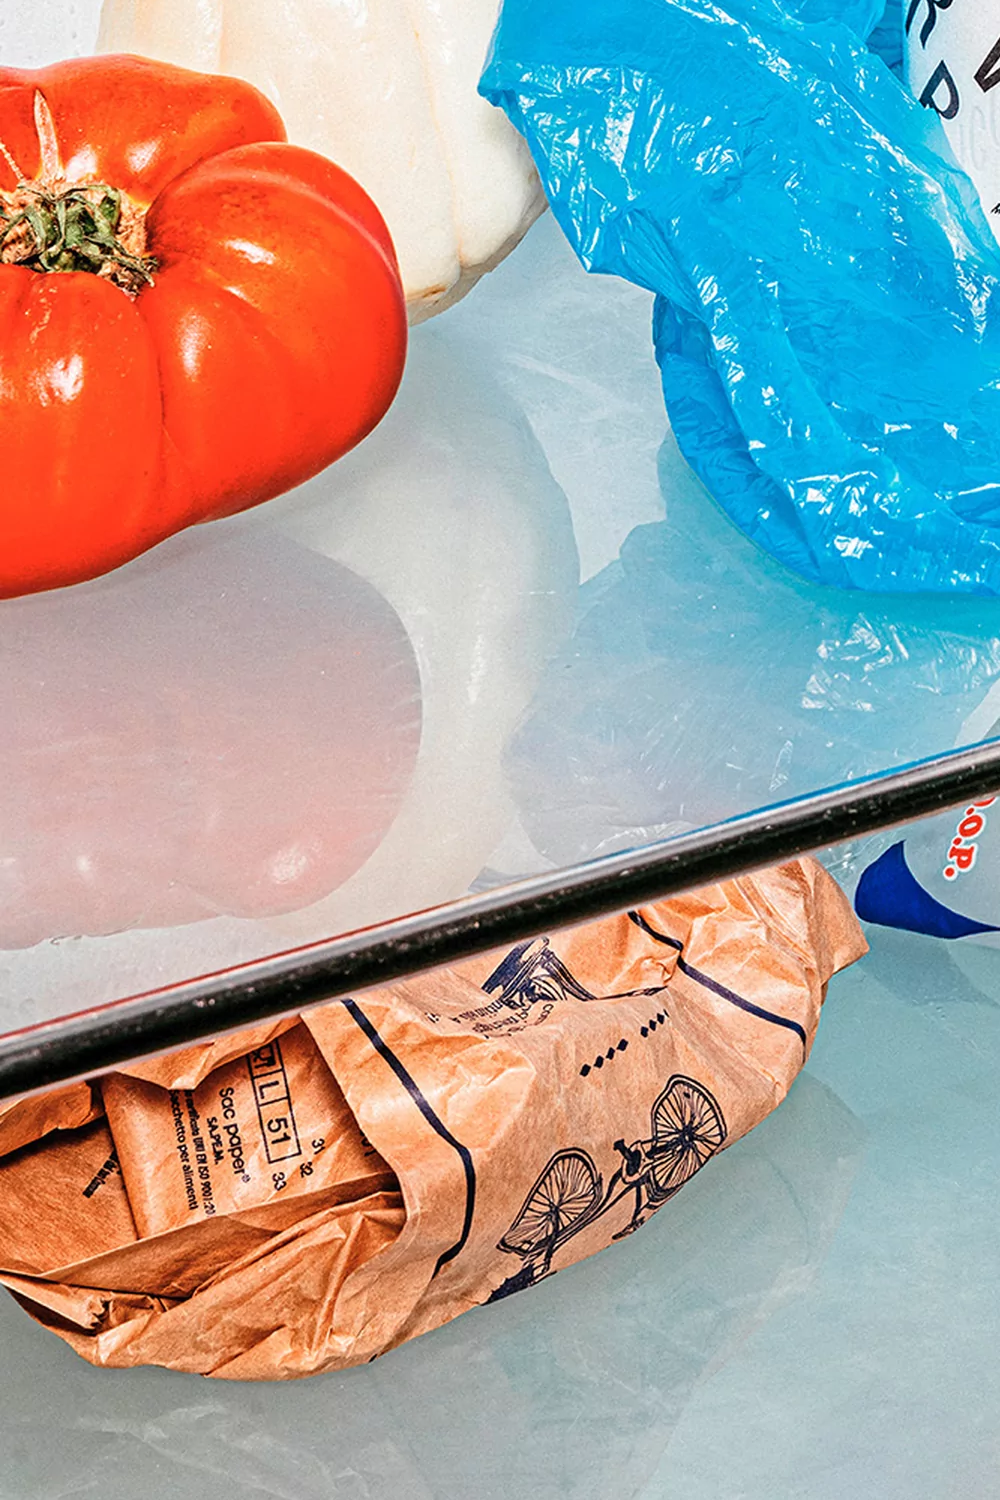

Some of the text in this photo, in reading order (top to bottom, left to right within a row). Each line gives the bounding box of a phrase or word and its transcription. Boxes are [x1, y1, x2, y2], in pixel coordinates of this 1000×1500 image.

[219, 1086, 236, 1120] Sac
[259, 1080, 291, 1145] L 51
[177, 1143, 190, 1163] per
[311, 1138, 325, 1155] 31
[198, 1165, 210, 1180] ISO
[299, 1161, 314, 1178] 32
[182, 1164, 199, 1211] alimenti
[272, 1171, 287, 1191] 33
